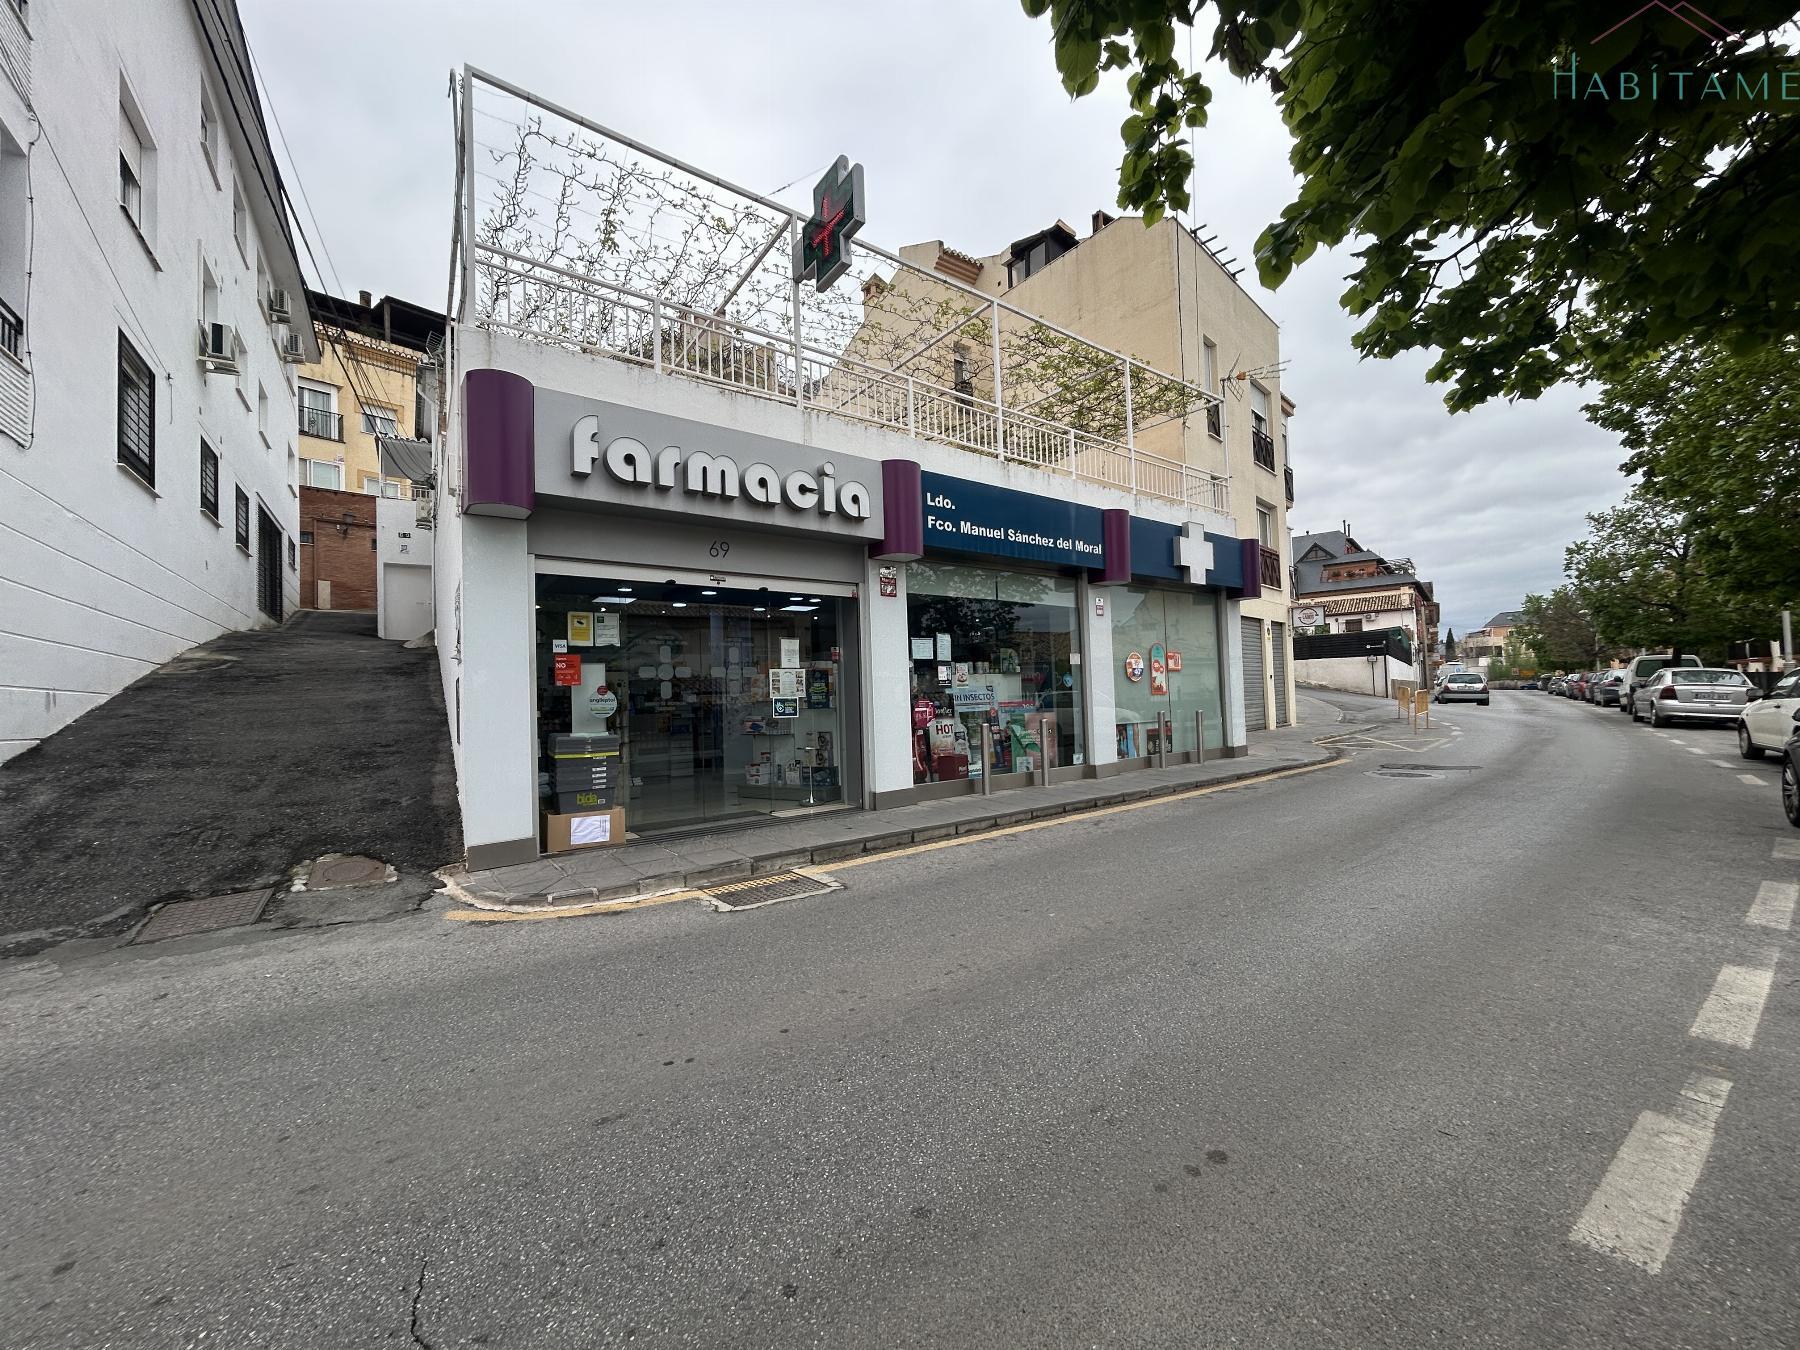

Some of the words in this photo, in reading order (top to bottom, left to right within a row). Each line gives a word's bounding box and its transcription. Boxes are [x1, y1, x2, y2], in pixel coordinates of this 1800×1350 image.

[570, 414, 871, 520] farmacia
[926, 493, 956, 510] Ldo.
[927, 516, 957, 532] Fco.
[960, 520, 1005, 540] Manuel
[1007, 528, 1054, 548] Sánchez
[1056, 537, 1072, 550] del
[1075, 540, 1102, 555] Moral
[709, 540, 730, 558] 69
[963, 693, 995, 702] INSECTOS
[935, 723, 954, 736] HOT
